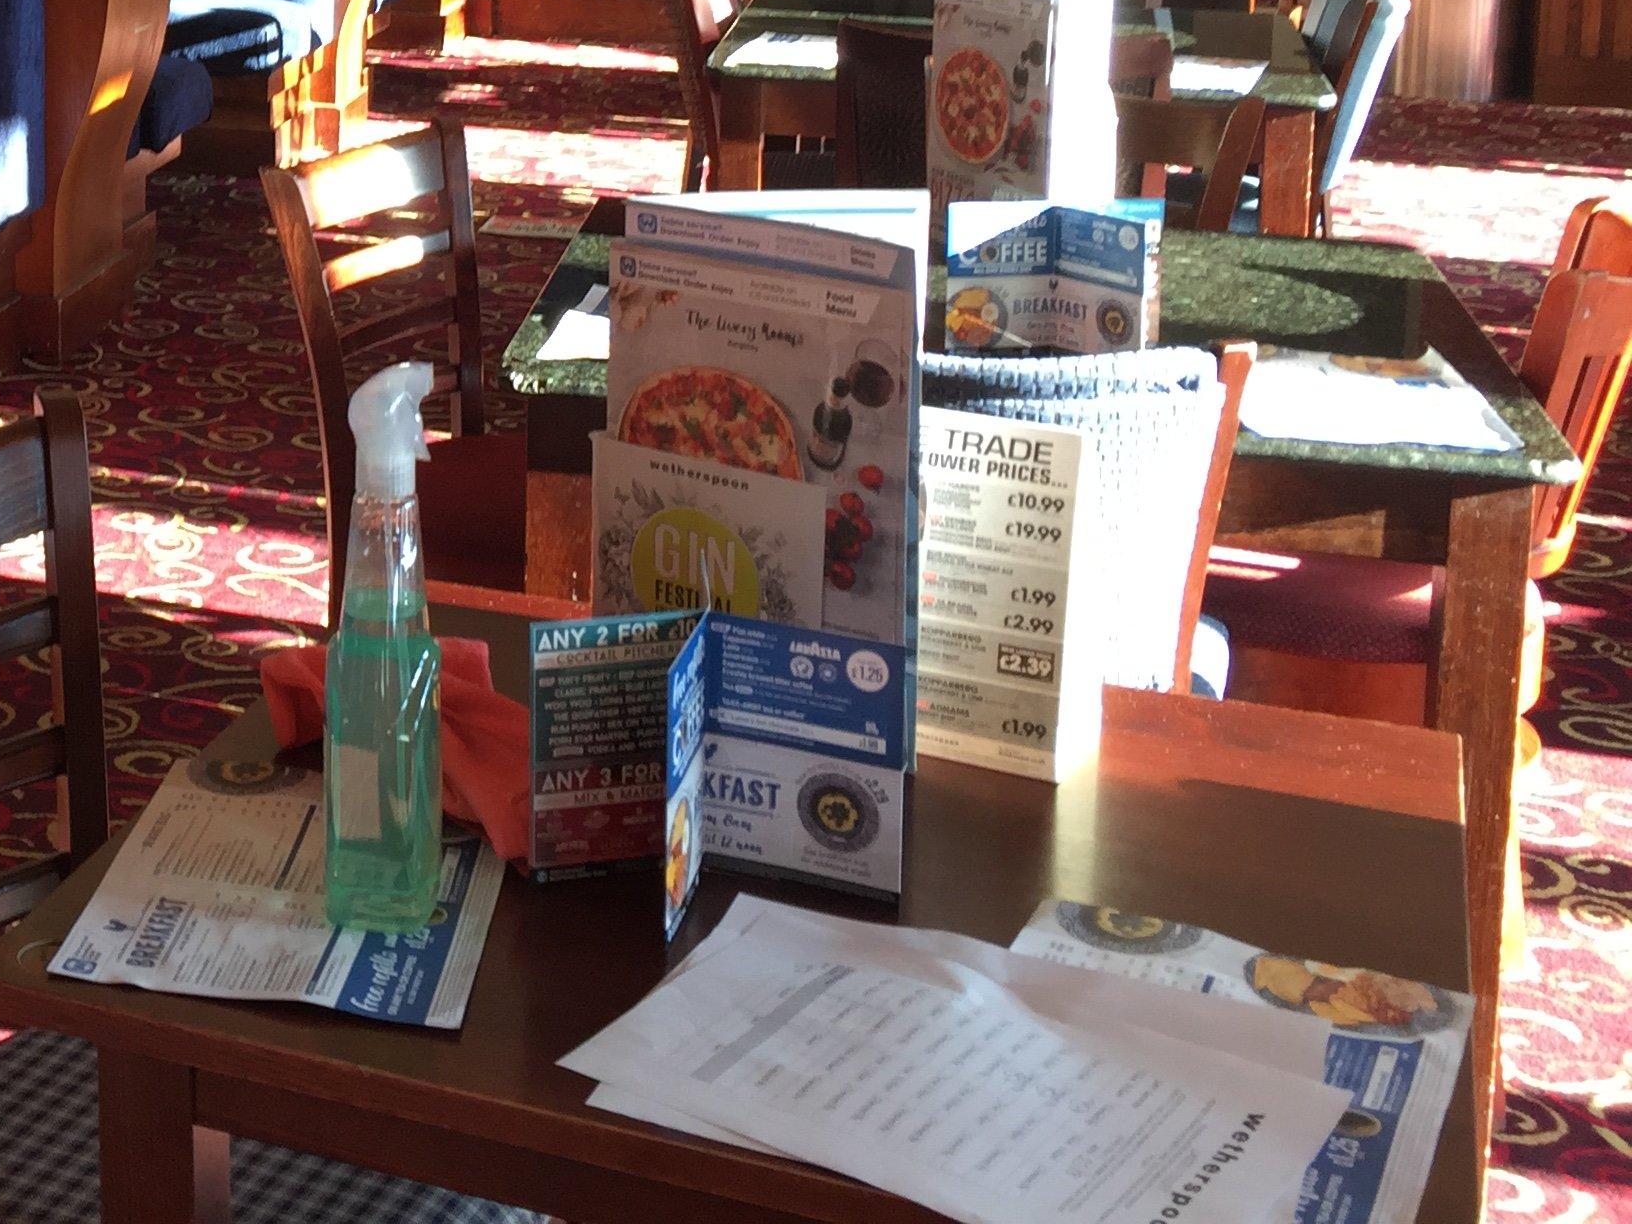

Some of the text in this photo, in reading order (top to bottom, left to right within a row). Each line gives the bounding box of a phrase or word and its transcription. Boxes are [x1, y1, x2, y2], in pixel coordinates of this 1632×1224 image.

[826, 289, 854, 305] Food
[1012, 296, 1088, 321] BREAKFAST
[685, 309, 710, 328] The
[825, 303, 857, 318] Menu
[945, 428, 1054, 466] TRADE
[649, 460, 749, 491] wetherspoon
[1007, 490, 1065, 514] £10.99
[1005, 520, 1062, 544] £19.99
[654, 523, 736, 596] GIN
[654, 579, 733, 614] FESTIAL
[1011, 585, 1057, 608] £1.99
[538, 627, 587, 651] ANY
[596, 626, 609, 646] 2
[618, 621, 659, 644] FOR
[1003, 614, 1054, 636] £2.99
[556, 643, 680, 665] COCKTAIL PITCHER
[999, 653, 1053, 678] £2.39
[1001, 718, 1048, 740] £1.99
[541, 761, 662, 792] ANY 3 FOR
[574, 791, 600, 806] MIX
[702, 771, 781, 810] KFAST
[125, 896, 189, 970] BREAKFAST
[1148, 1111, 1267, 1224] wetherspo
